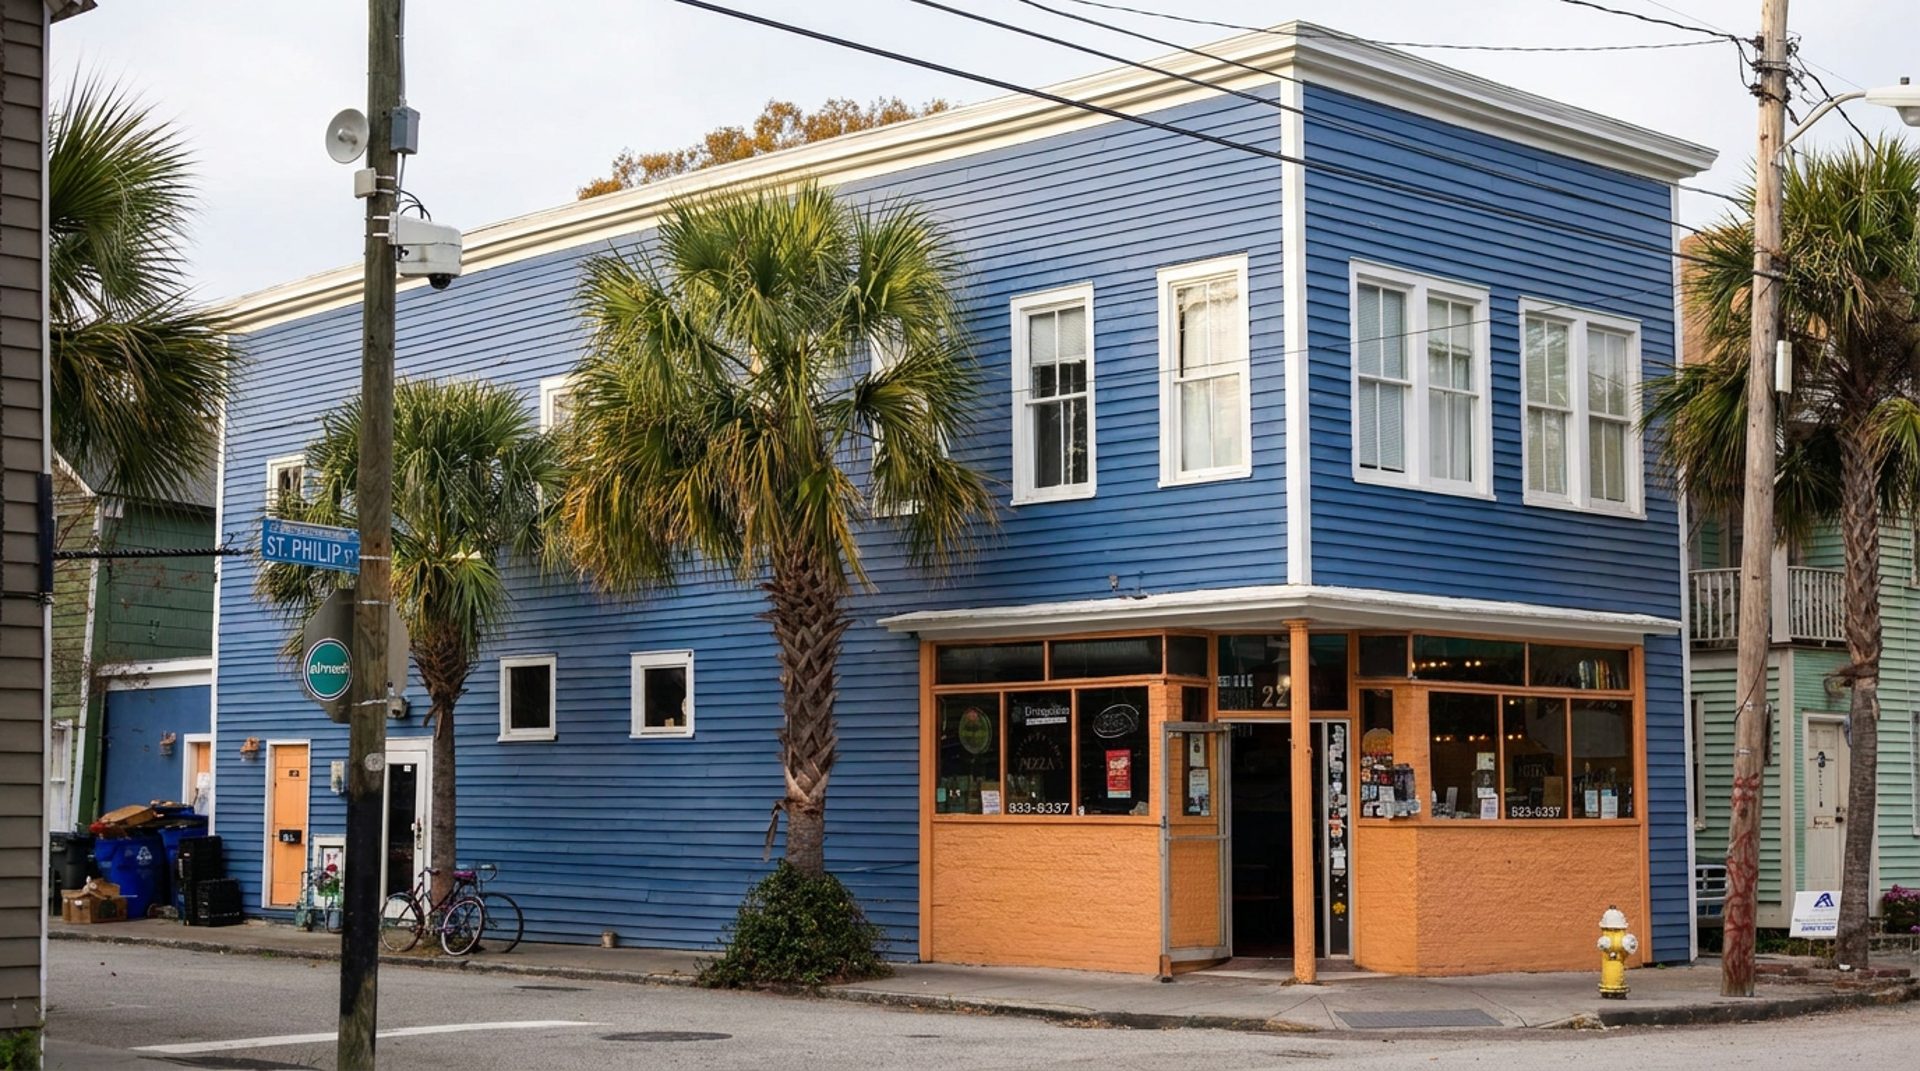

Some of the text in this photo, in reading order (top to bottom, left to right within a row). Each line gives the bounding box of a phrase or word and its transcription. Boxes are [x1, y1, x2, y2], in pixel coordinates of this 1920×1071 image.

[266, 535, 288, 558] ST.
[292, 539, 342, 564] PHILIP
[1261, 685, 1288, 708] 22
